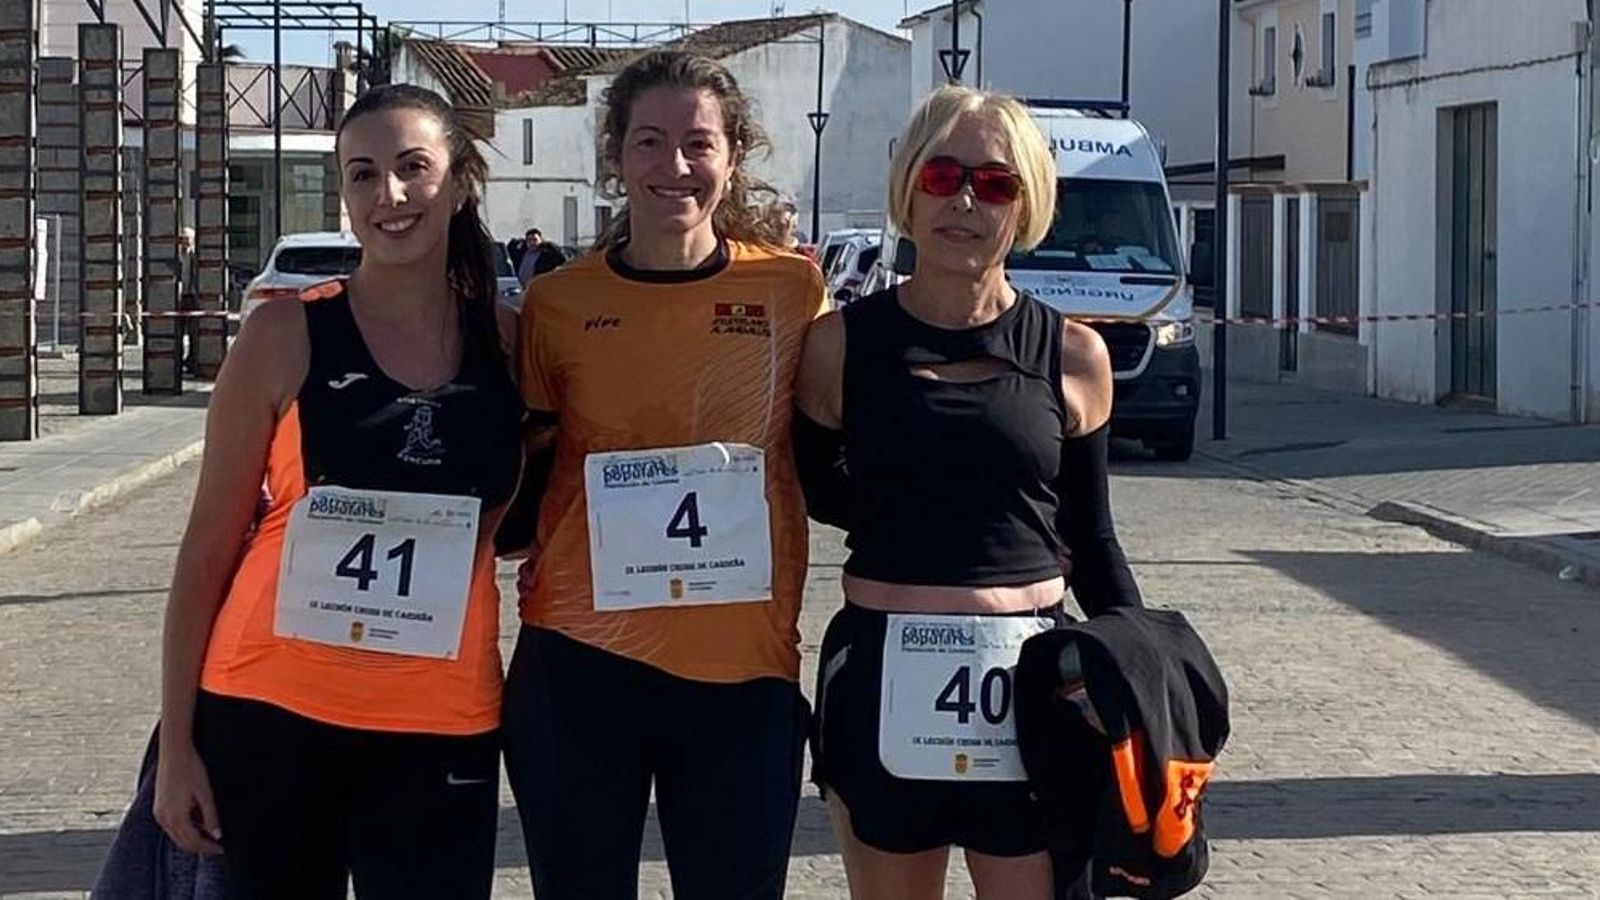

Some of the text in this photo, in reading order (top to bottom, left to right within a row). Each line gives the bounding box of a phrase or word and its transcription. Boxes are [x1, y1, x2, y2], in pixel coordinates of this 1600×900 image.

[666, 491, 708, 548] 4
[335, 533, 416, 597] 41
[902, 633, 976, 647] populares
[935, 666, 1012, 725] 40
